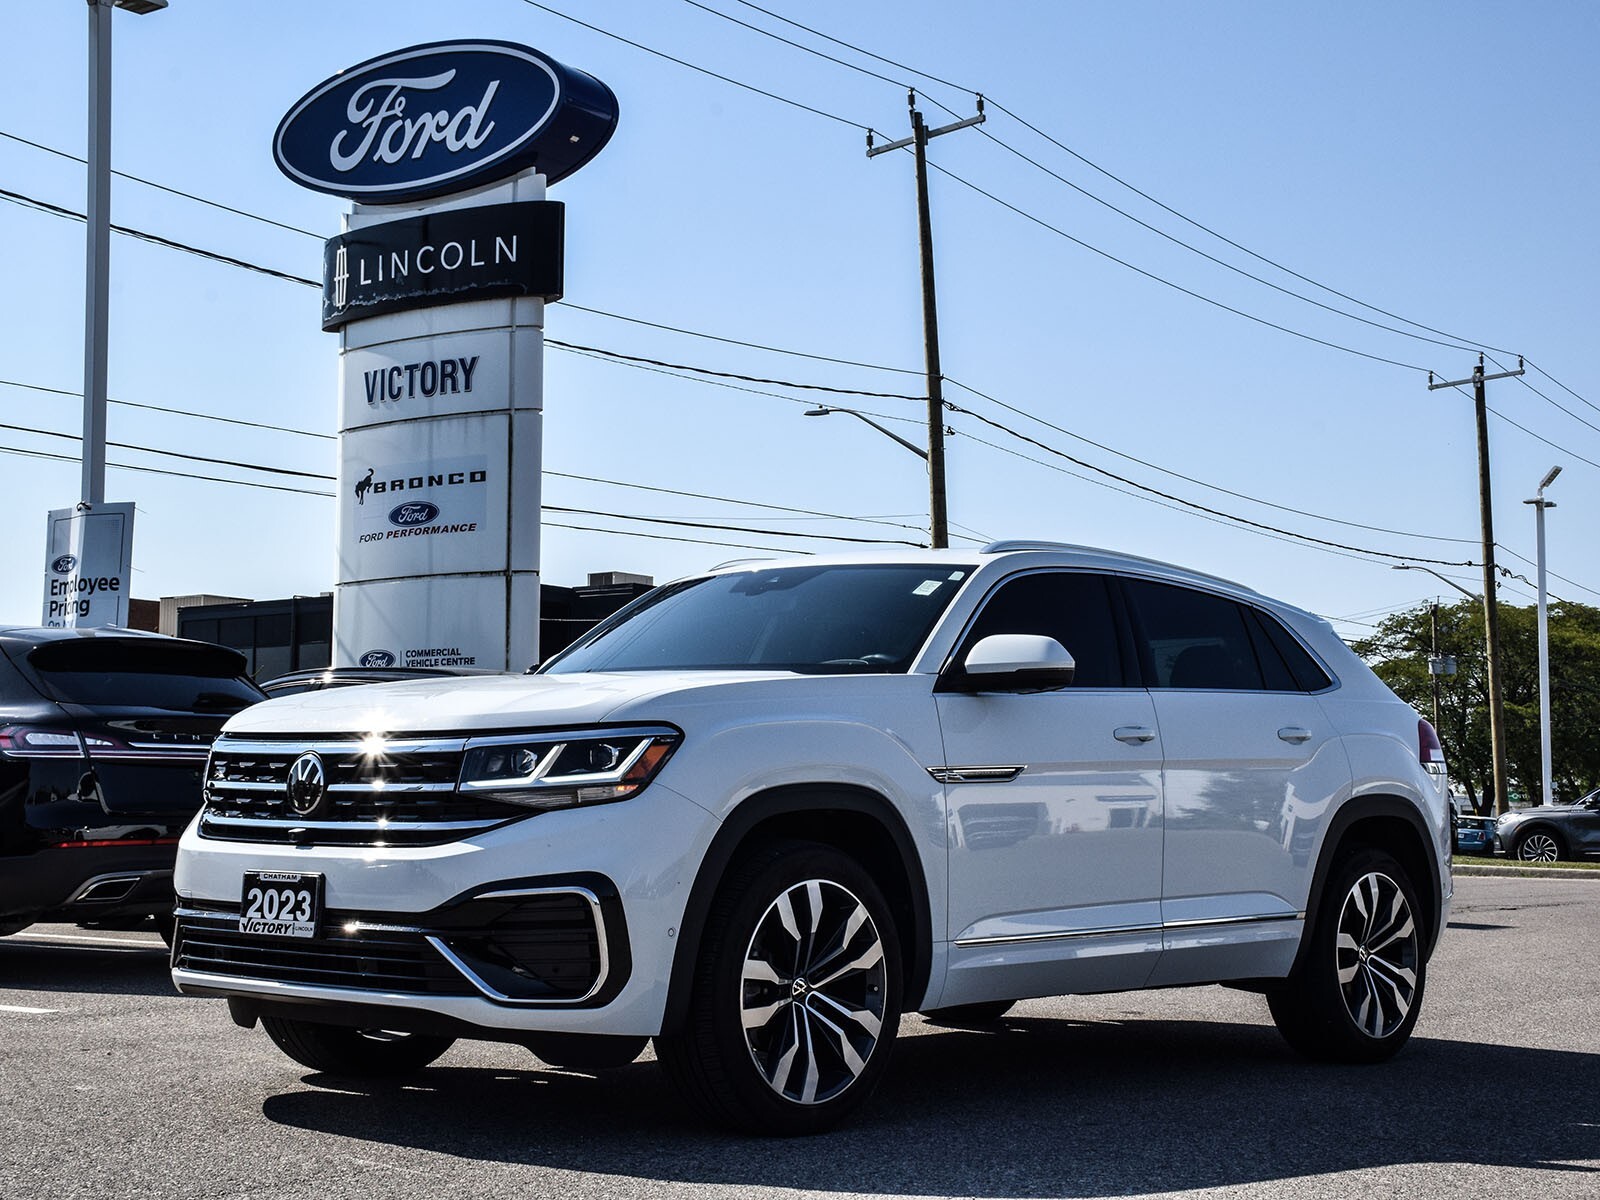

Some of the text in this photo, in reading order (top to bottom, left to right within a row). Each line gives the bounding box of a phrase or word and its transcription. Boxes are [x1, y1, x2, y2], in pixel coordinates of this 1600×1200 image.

[330, 68, 500, 172] Ford
[359, 235, 518, 285] LINCOLN
[364, 356, 480, 405] VICTORY
[374, 470, 487, 494] BRONCO
[398, 504, 429, 523] Ford
[359, 523, 477, 543] FORD PERFORMANCE
[50, 574, 120, 599] Employee
[365, 653, 389, 667] Ford
[405, 657, 475, 667] VEHICLE CENTRE
[406, 648, 461, 658] COMMERCIAL
[246, 887, 312, 922] 2023
[241, 918, 293, 935] VICTORY
